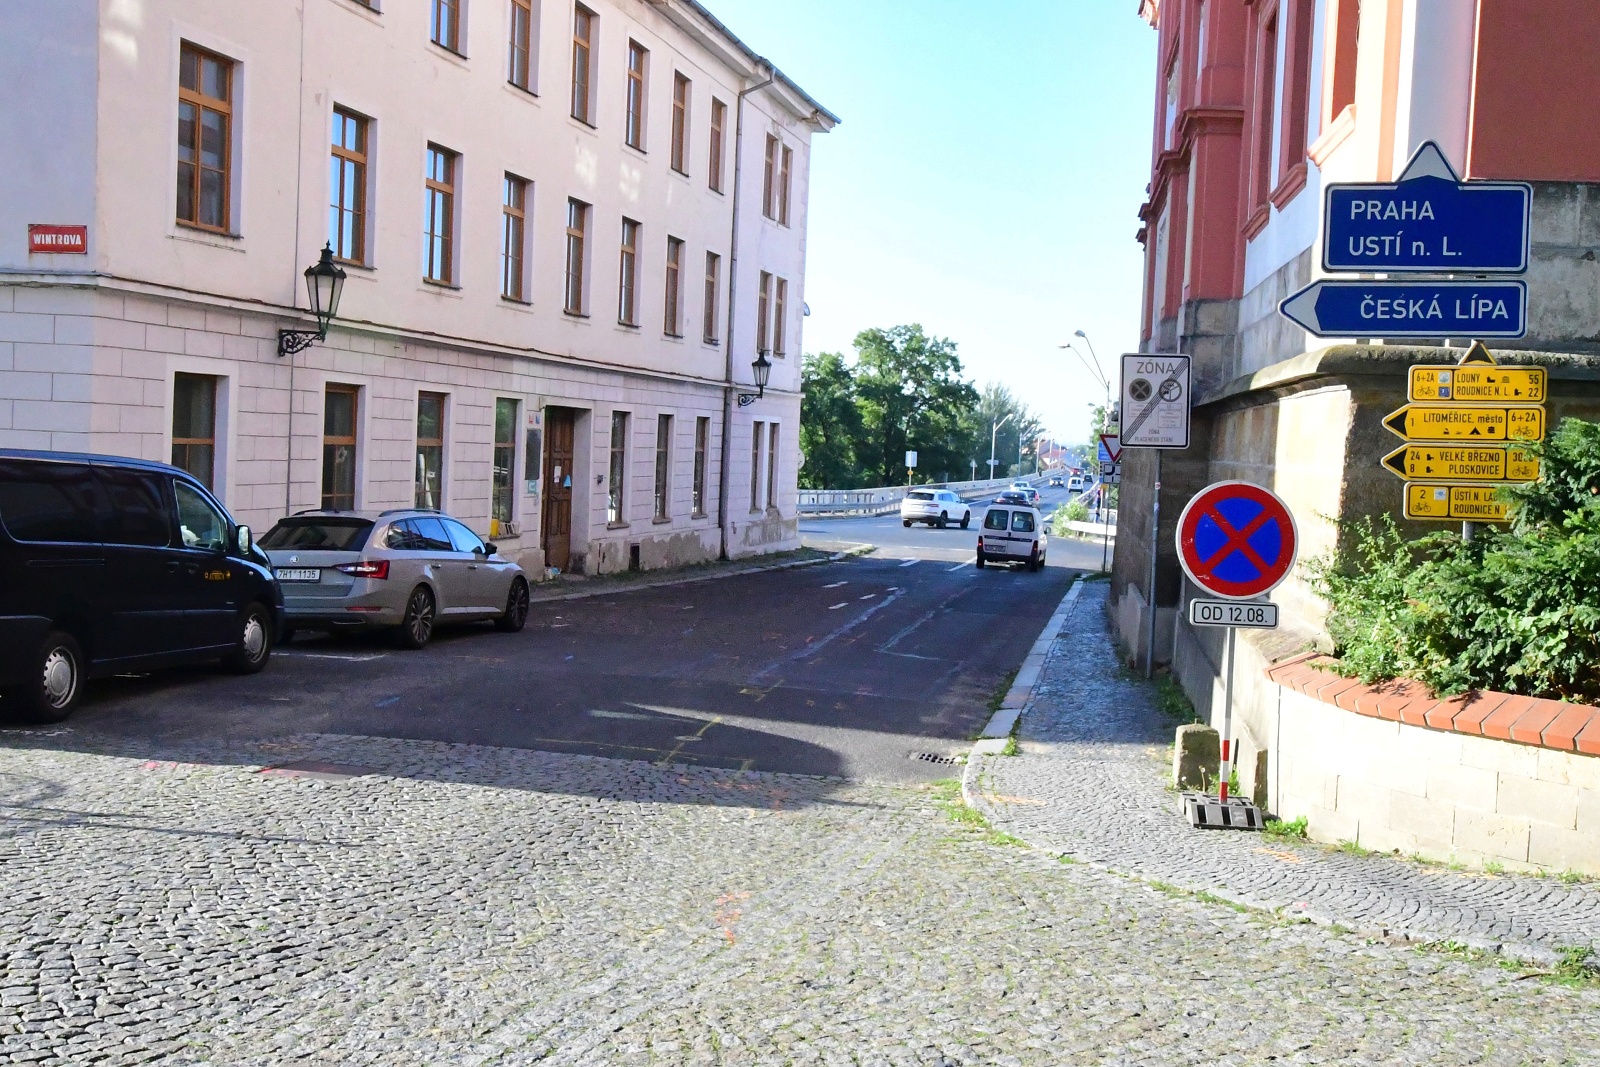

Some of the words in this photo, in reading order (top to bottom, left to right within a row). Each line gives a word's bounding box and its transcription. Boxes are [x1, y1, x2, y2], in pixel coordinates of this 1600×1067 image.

[1350, 200, 1435, 220] PRAHA
[33, 233, 82, 245] WINTROVA
[1349, 230, 1403, 256] USTÍ
[1411, 240, 1430, 256] n.
[1442, 236, 1462, 256] L.
[1360, 294, 1443, 319] ČESKÁ
[1455, 294, 1509, 319] LÍPA
[1136, 359, 1175, 374] ZÓNA
[1416, 372, 1435, 382] 6+2A
[1456, 373, 1480, 383] LOUNY
[1528, 374, 1539, 384] 55
[1456, 386, 1492, 396] ROUDNICE
[1528, 387, 1539, 397] 22
[1411, 417, 1415, 427] 1
[1477, 413, 1503, 423] město
[1511, 412, 1537, 422] 6+2A
[1410, 451, 1420, 460] 24
[1439, 450, 1465, 461] VELKÉ
[1467, 450, 1500, 462] BŘEZNO
[1409, 463, 1415, 472] 8
[1448, 464, 1500, 475] PLOSKOVICE
[1420, 489, 1426, 499] 2
[1454, 489, 1471, 500] ÚSTÍ
[1453, 504, 1492, 514] ROUDNICE
[278, 570, 292, 579] 7H1
[298, 570, 316, 579] 1135
[1201, 605, 1223, 620] OD
[1228, 607, 1268, 623] 12.08.
